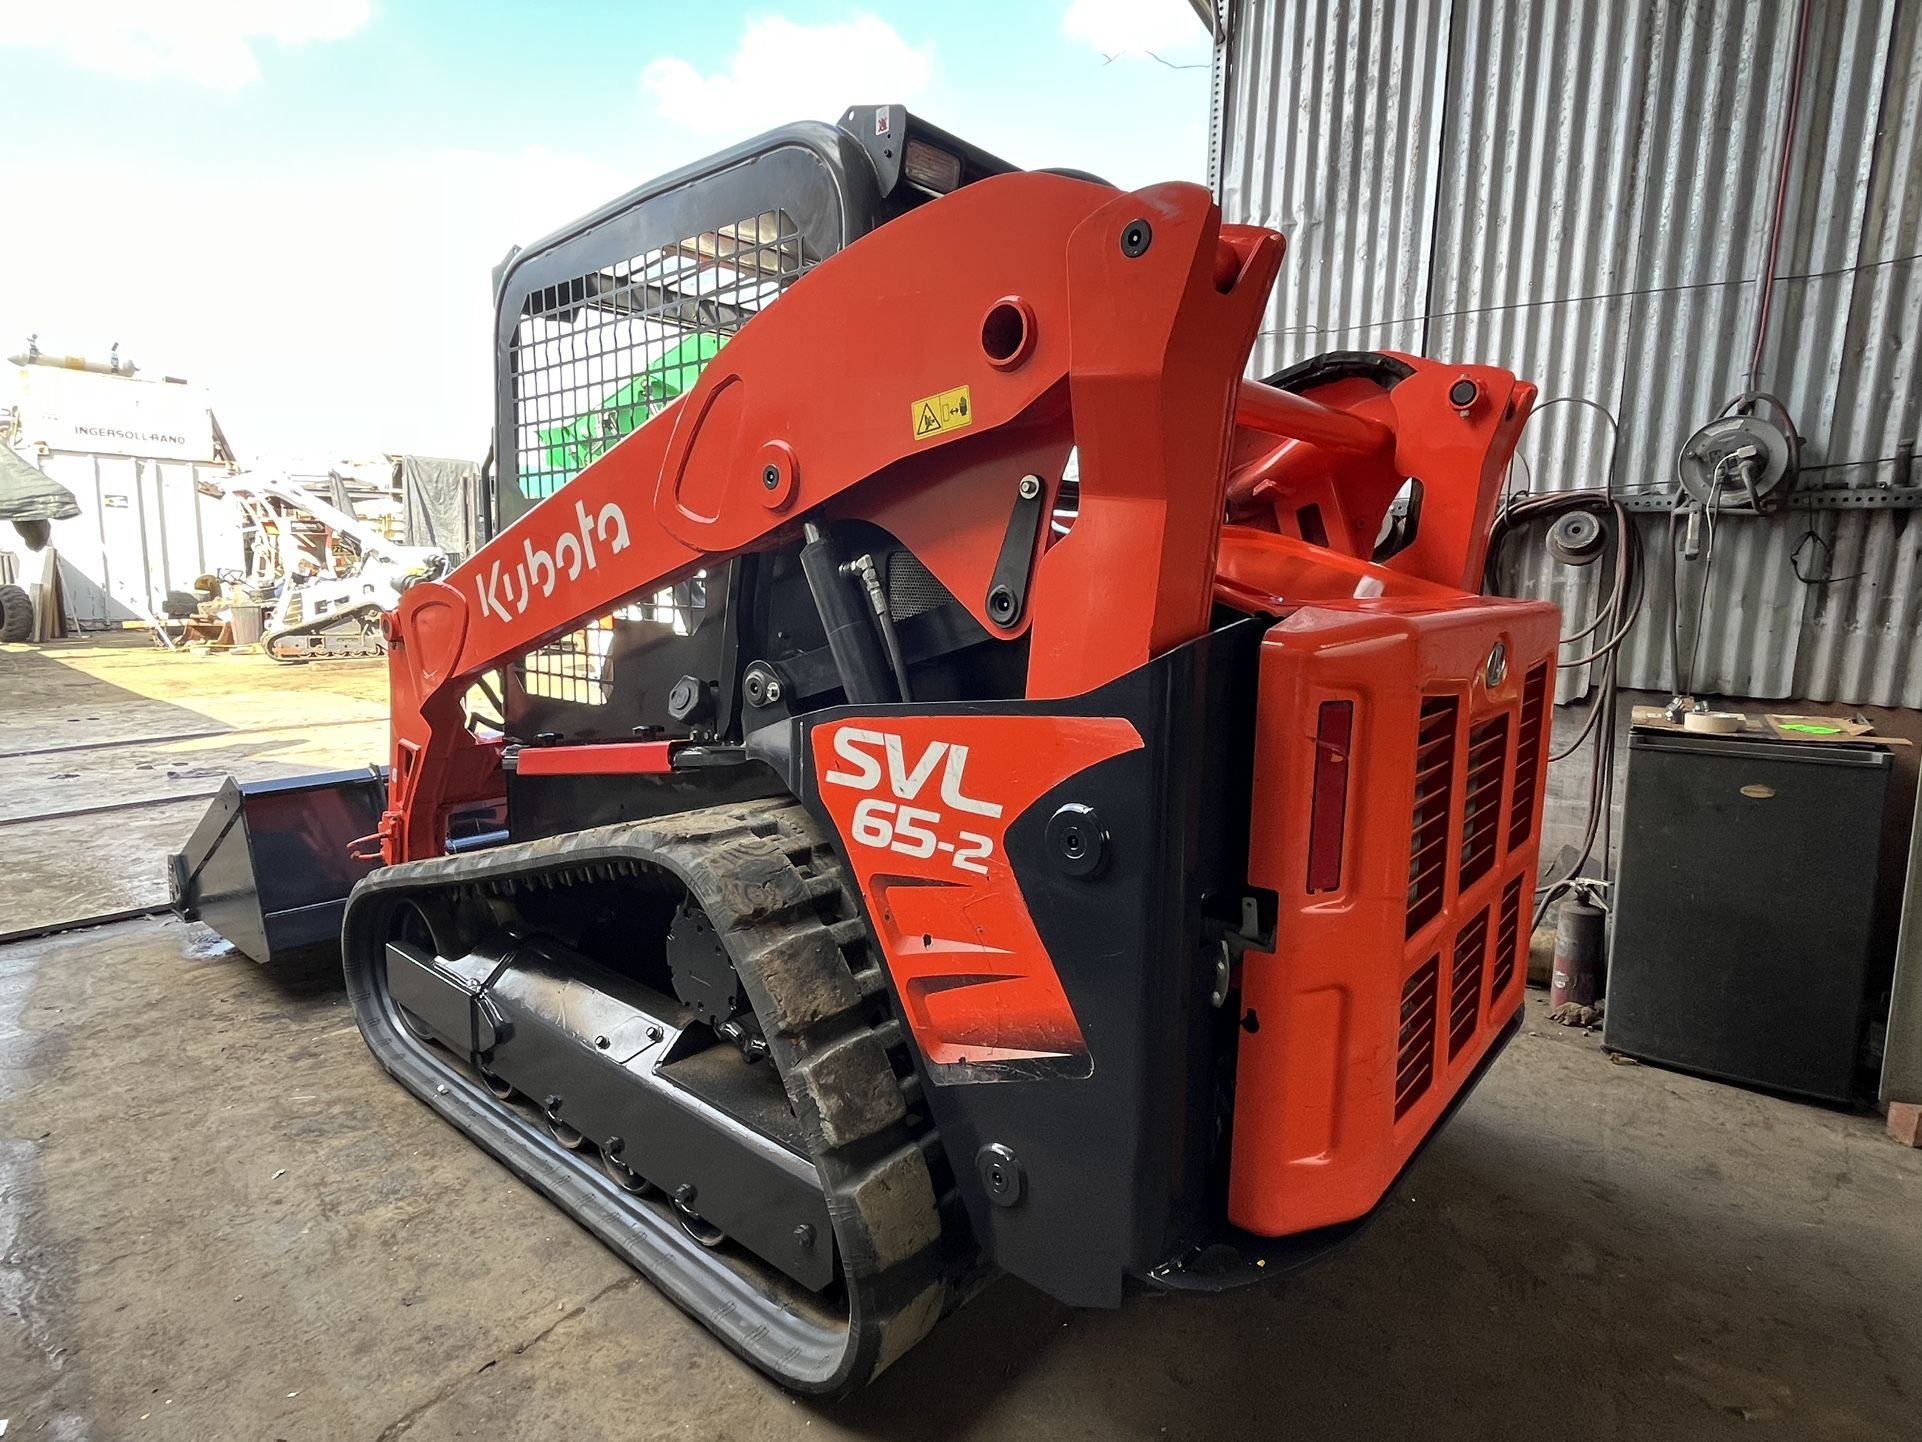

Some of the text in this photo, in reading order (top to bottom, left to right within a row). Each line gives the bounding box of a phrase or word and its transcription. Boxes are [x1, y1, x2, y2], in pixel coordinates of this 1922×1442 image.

[475, 500, 630, 623] Kubota
[825, 726, 1003, 818] SVL
[851, 799, 994, 874] 65-2
